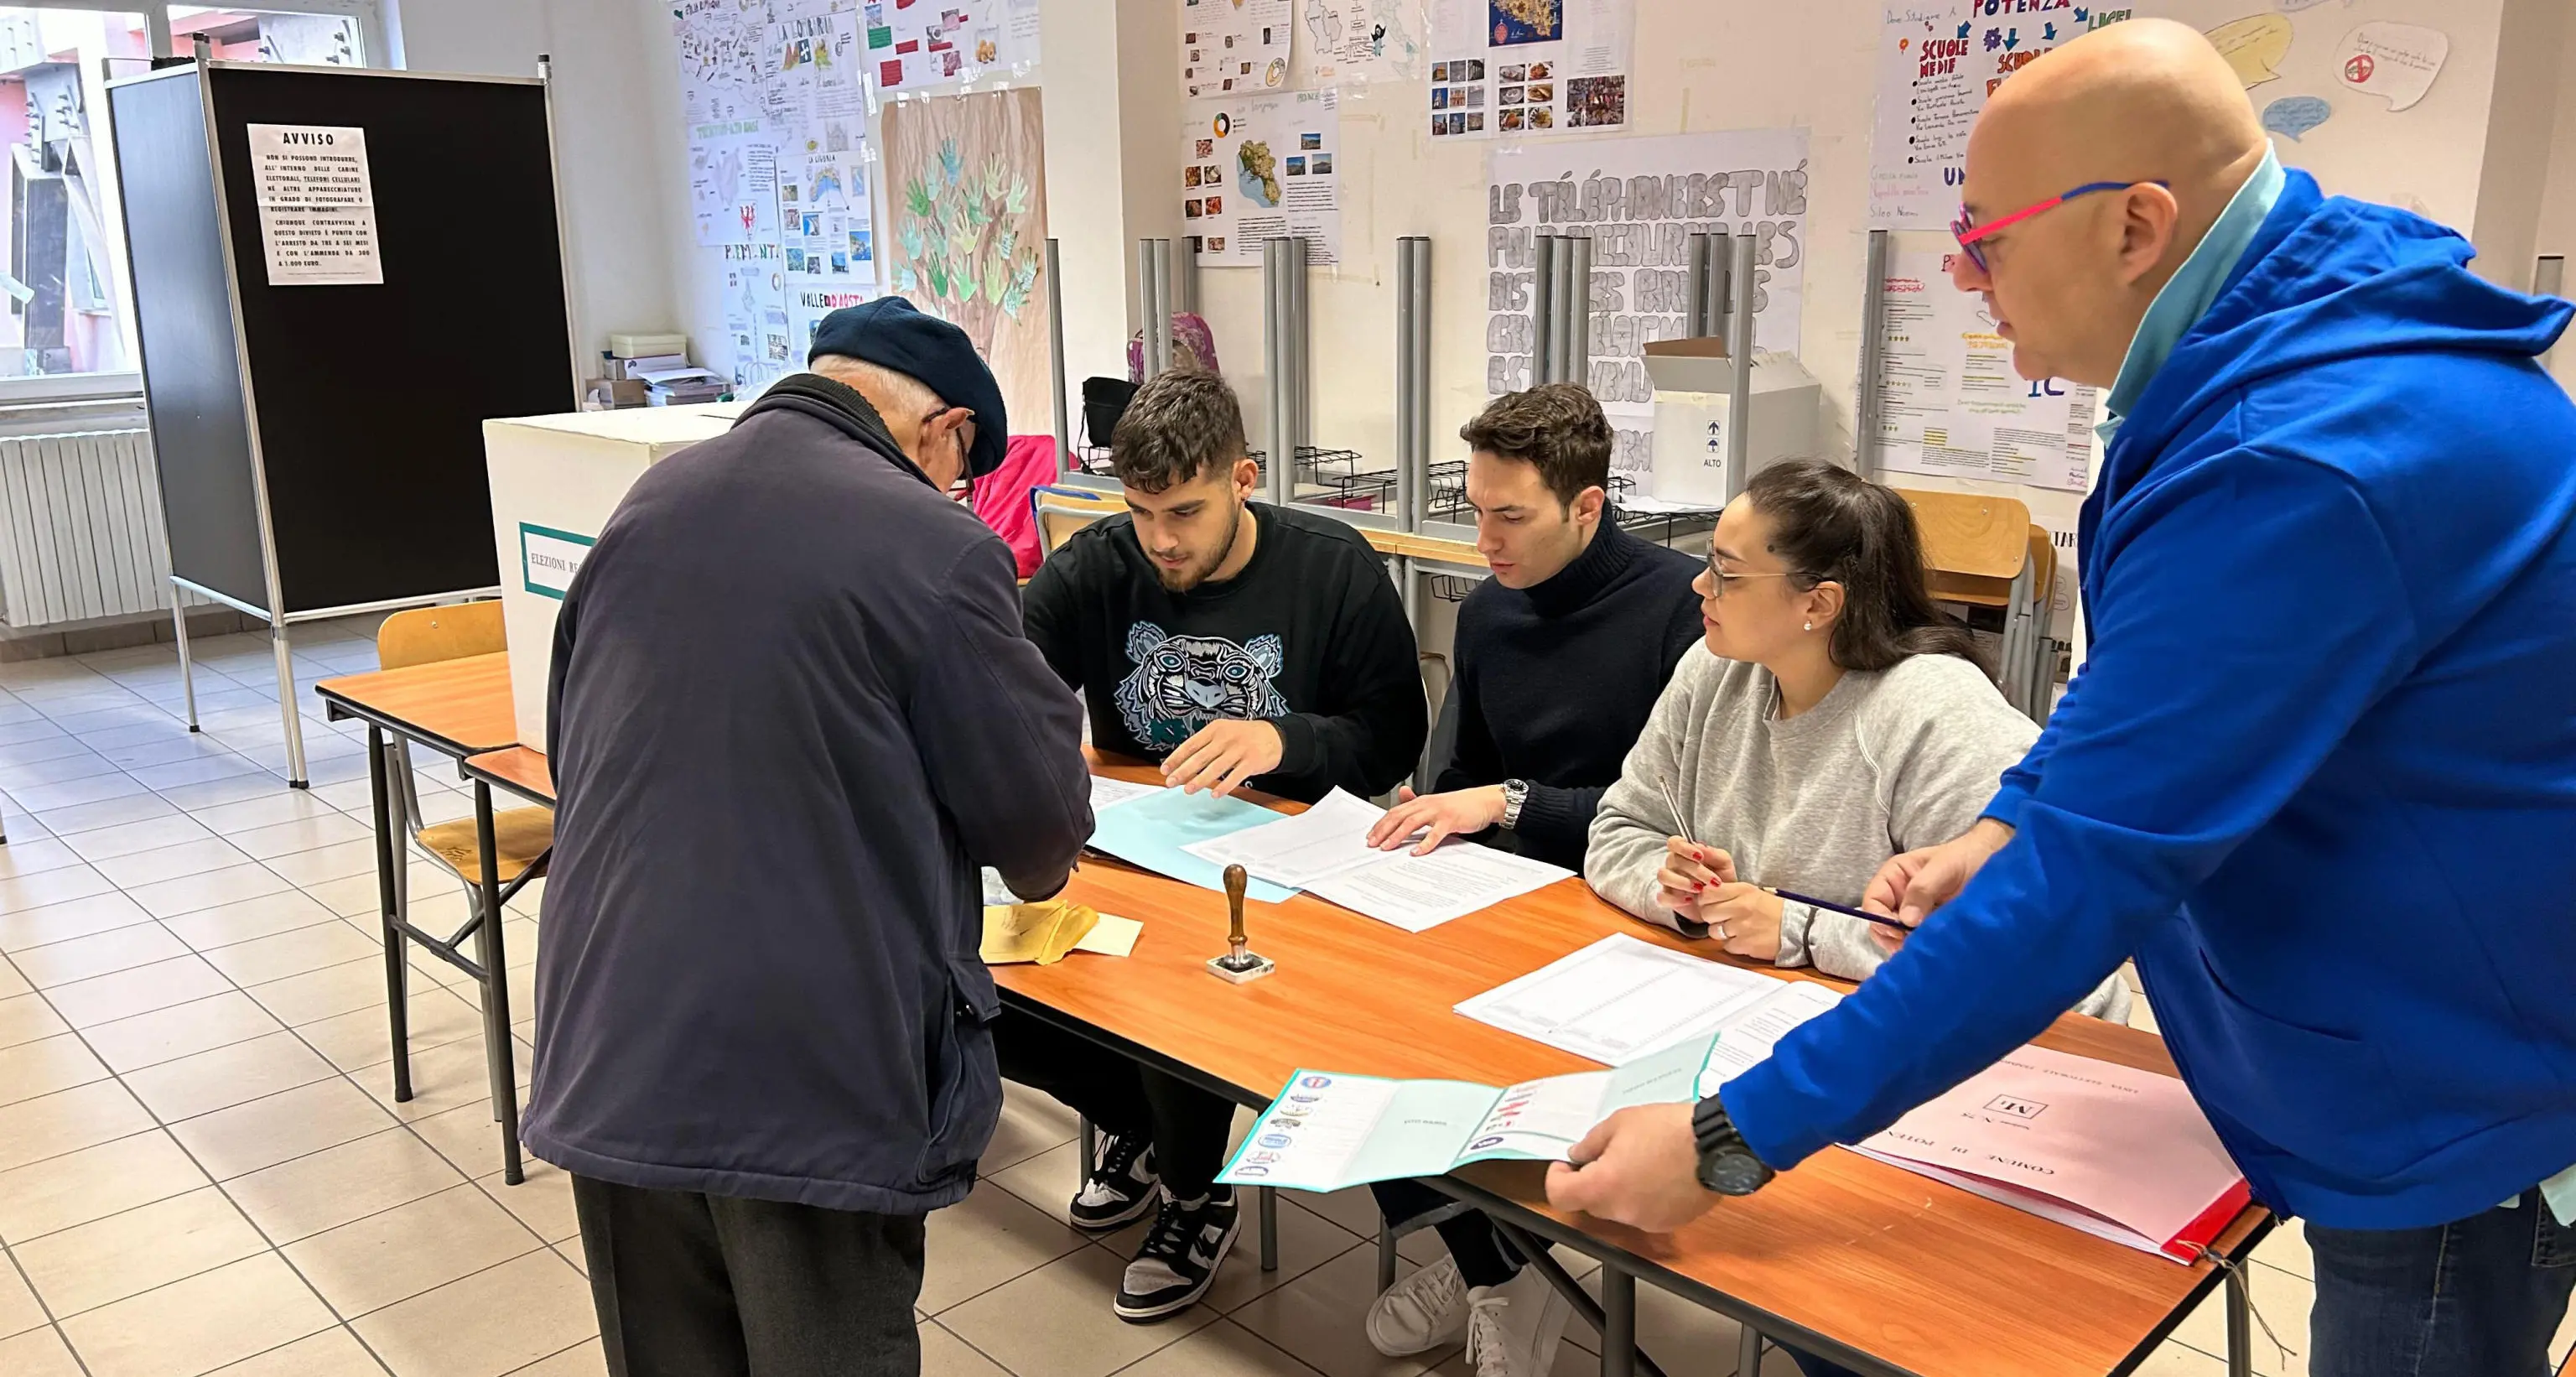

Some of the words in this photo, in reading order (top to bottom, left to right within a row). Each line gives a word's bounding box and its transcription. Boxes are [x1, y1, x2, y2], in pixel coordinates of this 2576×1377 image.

[1973, 0, 2071, 18] POTENZA
[1919, 39, 1969, 63] SCUOLE
[1997, 47, 2053, 74] SCUO
[283, 133, 334, 145] AVVISO
[1489, 184, 1524, 224] LE
[1528, 169, 1687, 223] TÉLÉPHONE
[1686, 169, 1764, 218] EST
[1765, 158, 1808, 216] NÉ
[800, 292, 823, 309] VALLE
[1703, 459, 1722, 468] ALTO
[531, 553, 566, 571] ELEZIONI
[1950, 1146, 1969, 1155] DI
[1984, 1154, 2055, 1175] COMUNE
